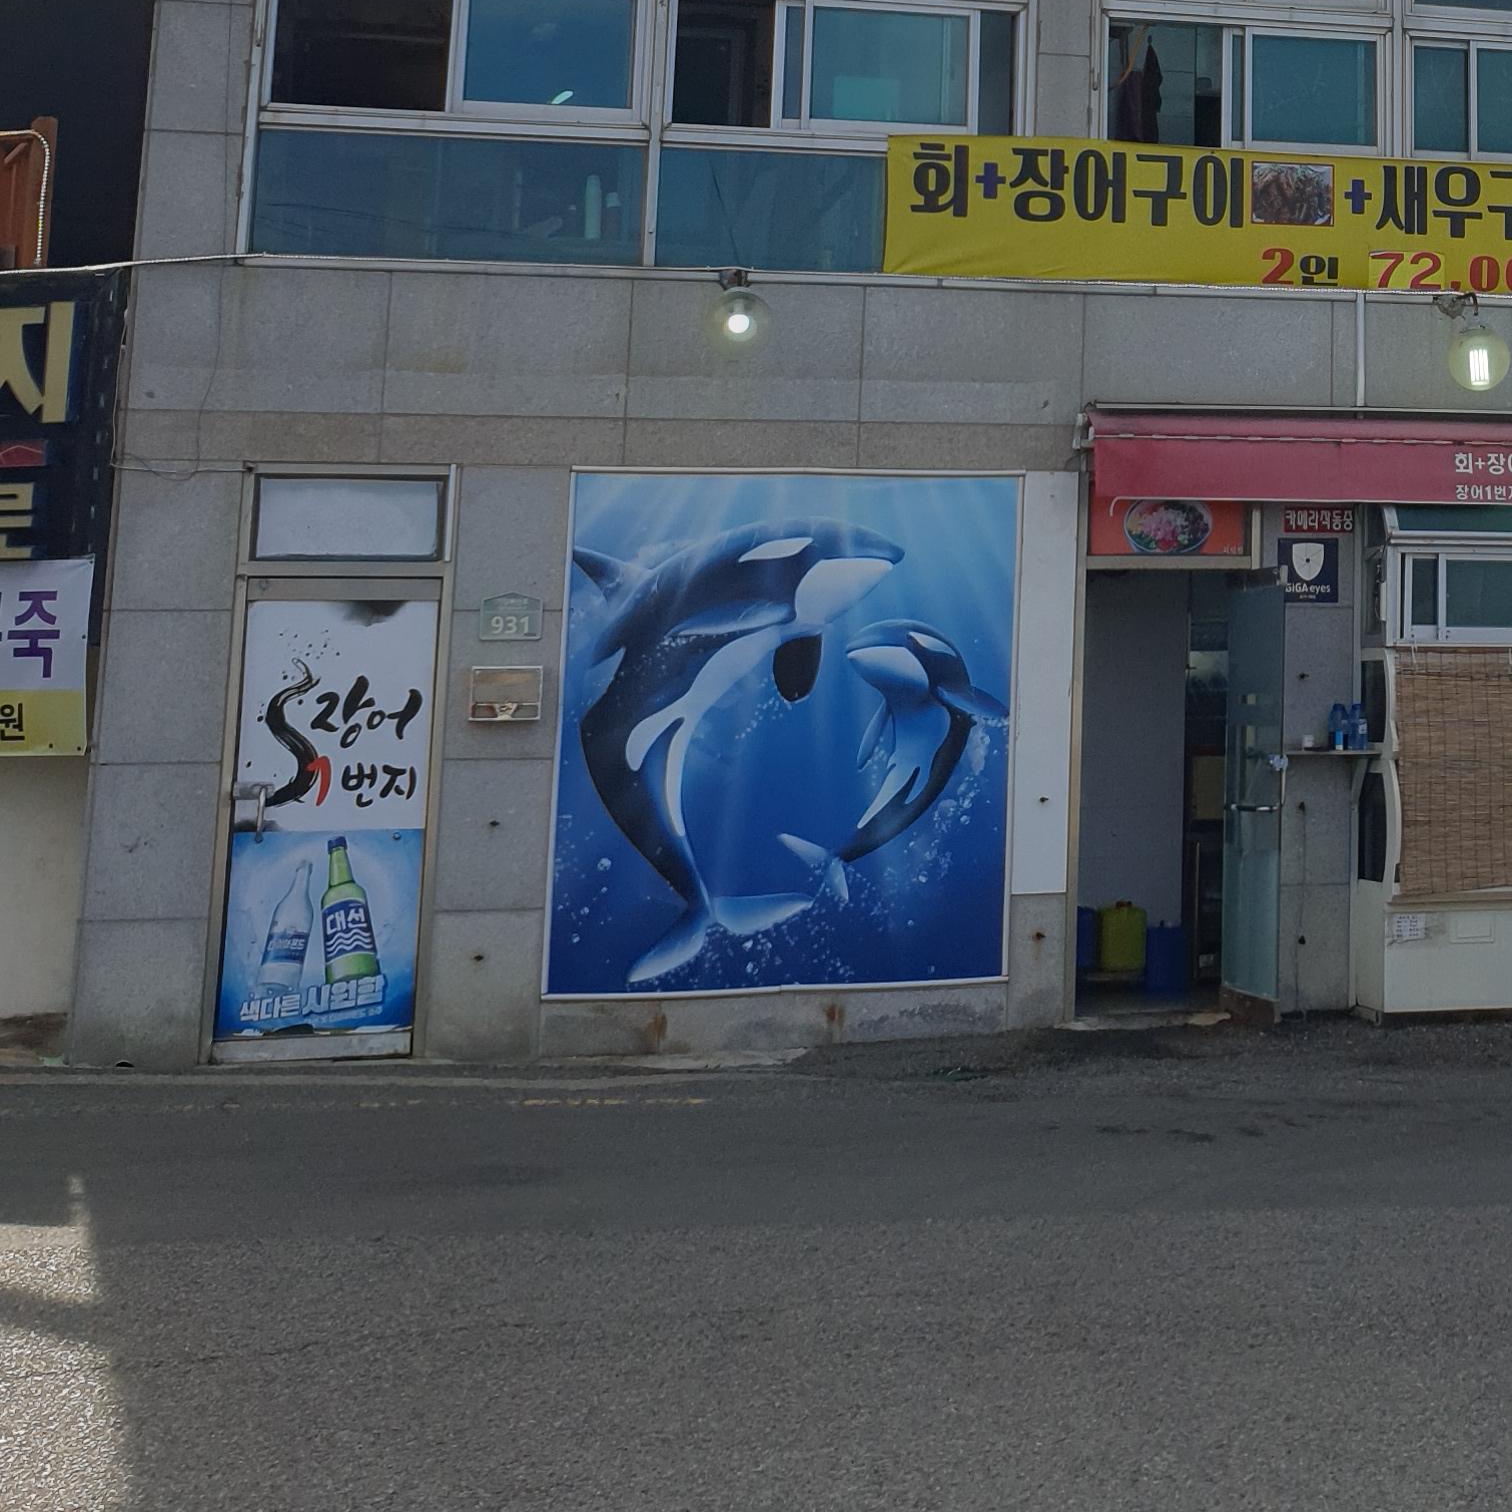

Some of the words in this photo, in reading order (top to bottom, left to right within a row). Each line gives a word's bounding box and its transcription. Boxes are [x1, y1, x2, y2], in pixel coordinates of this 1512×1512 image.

[1261, 248, 1339, 287] 2인
[1285, 583, 1309, 593] GIGA
[491, 615, 529, 634] 931
[310, 675, 423, 748] 장어
[325, 907, 367, 935] 대선
[240, 994, 301, 1022] 색다른
